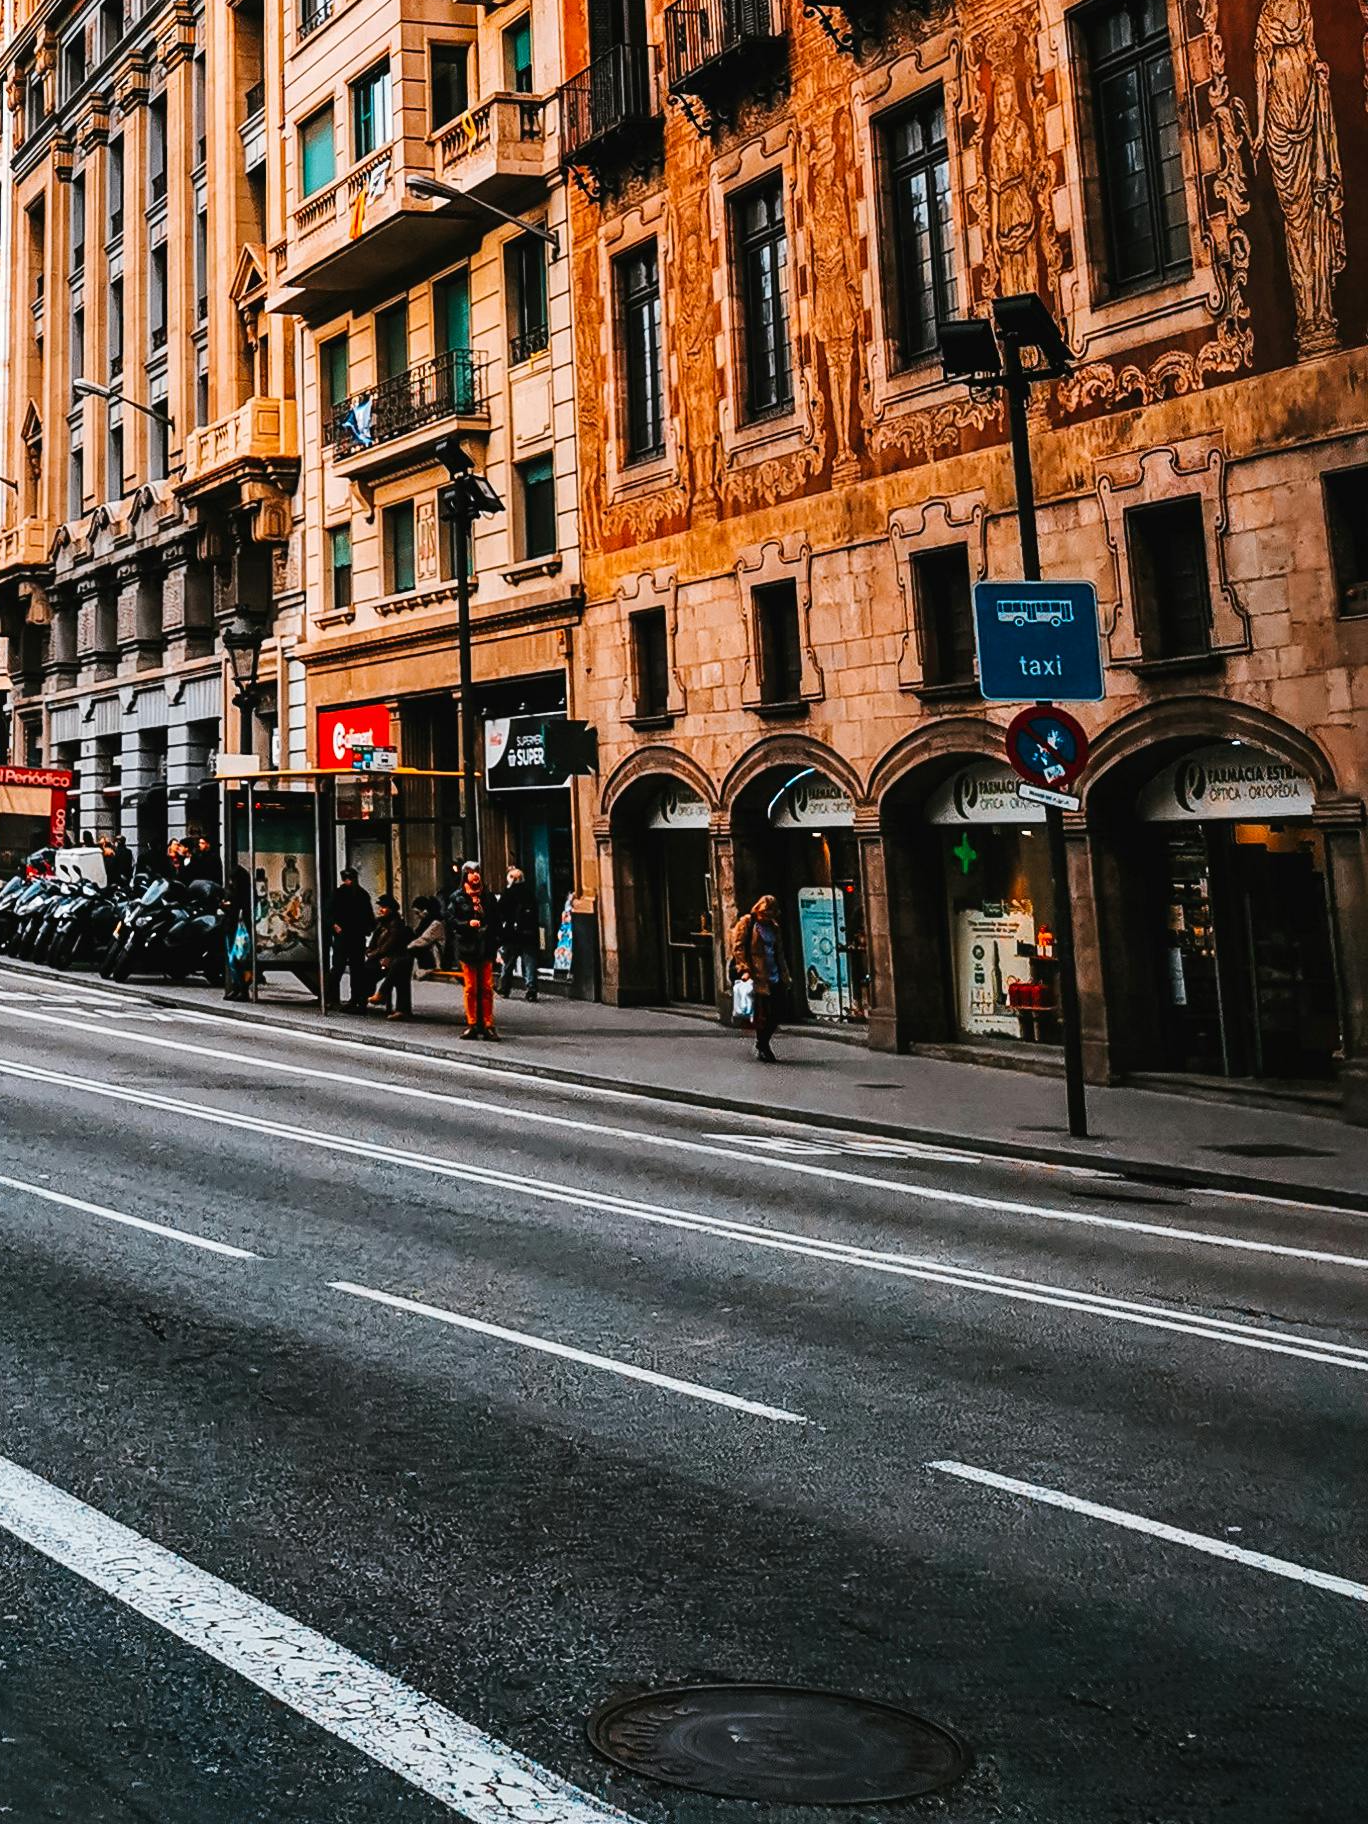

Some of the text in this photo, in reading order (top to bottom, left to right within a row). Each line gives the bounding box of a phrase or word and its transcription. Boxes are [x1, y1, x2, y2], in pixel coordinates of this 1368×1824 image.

[1019, 654, 1062, 675] taxi
[5, 769, 70, 787] Periódico
[1208, 765, 1264, 783] FARMACIA
